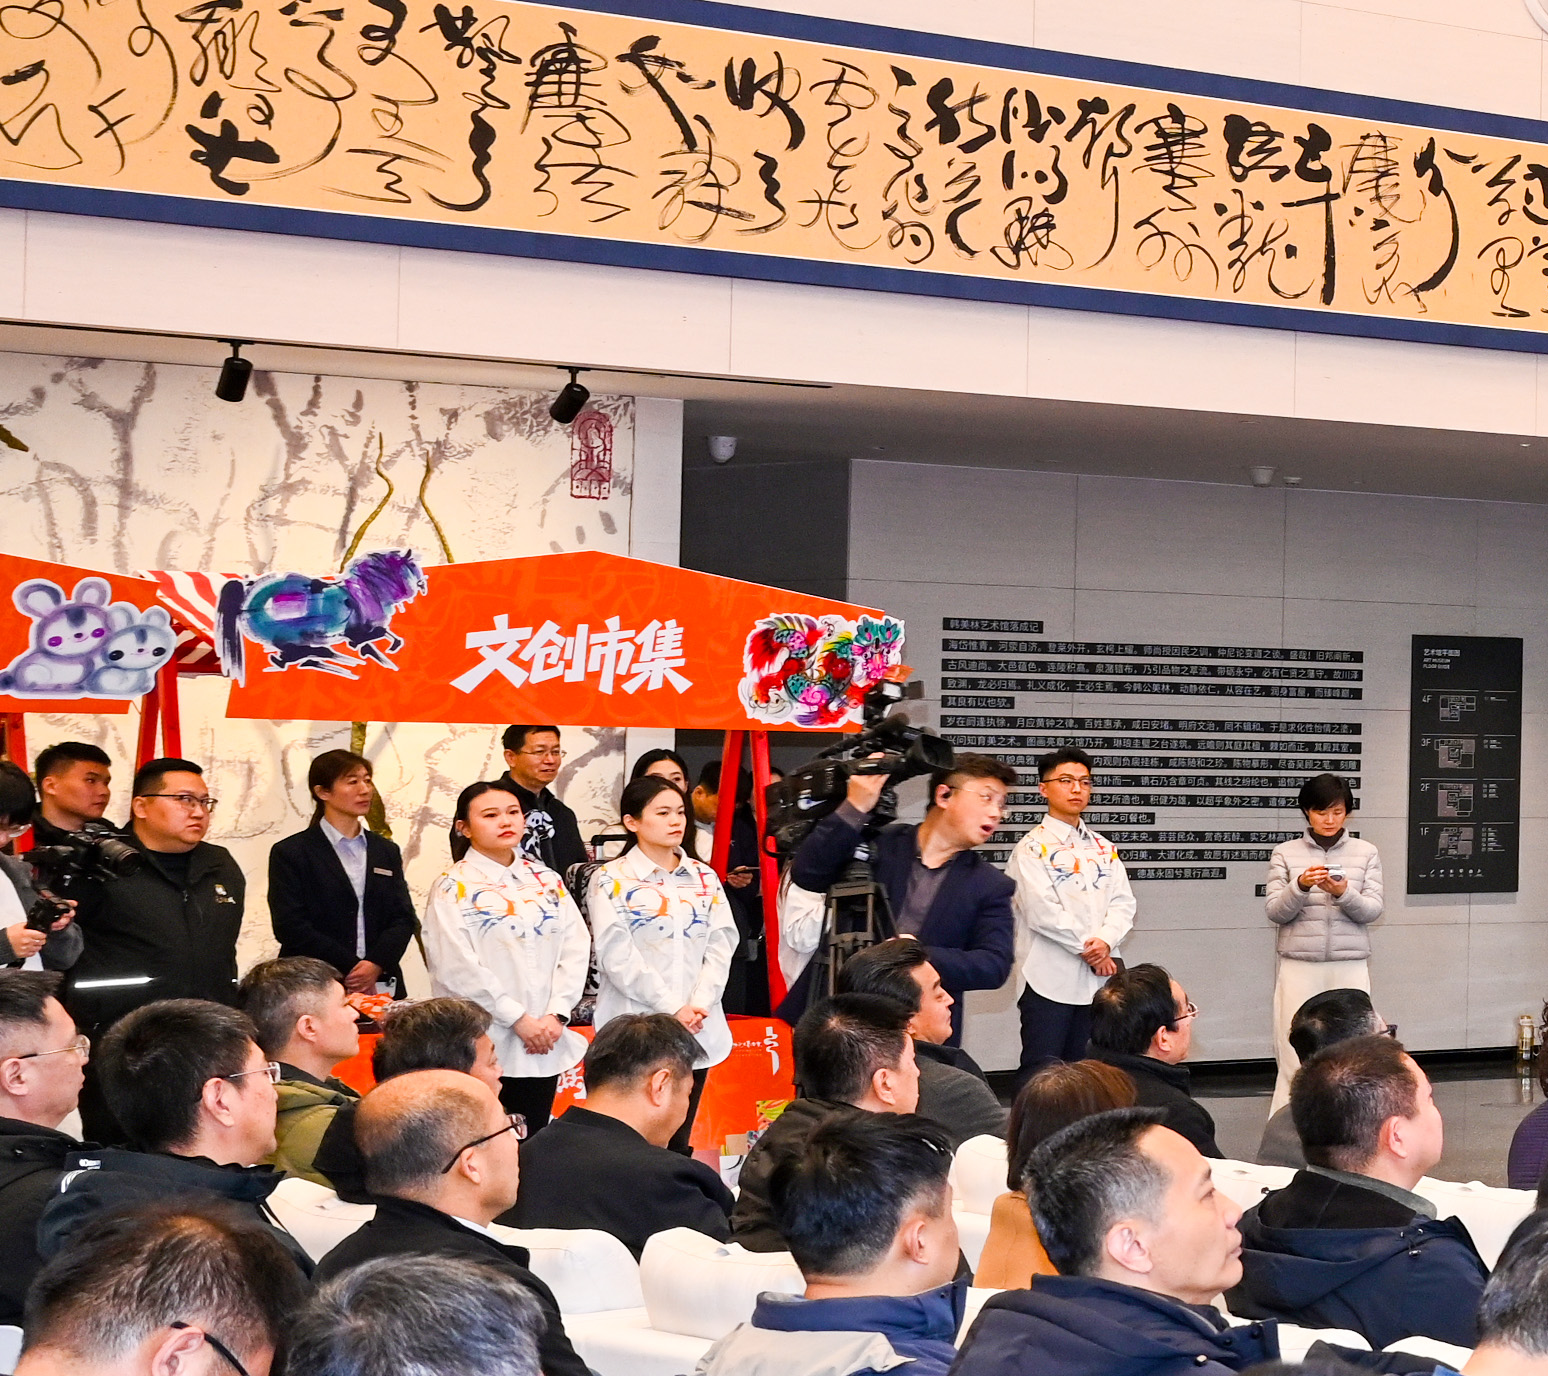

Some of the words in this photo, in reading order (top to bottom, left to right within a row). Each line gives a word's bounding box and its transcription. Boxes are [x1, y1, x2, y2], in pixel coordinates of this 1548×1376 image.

[950, 618, 1040, 632] 韩美林艺术馆落成记
[450, 614, 692, 694] 文创市集
